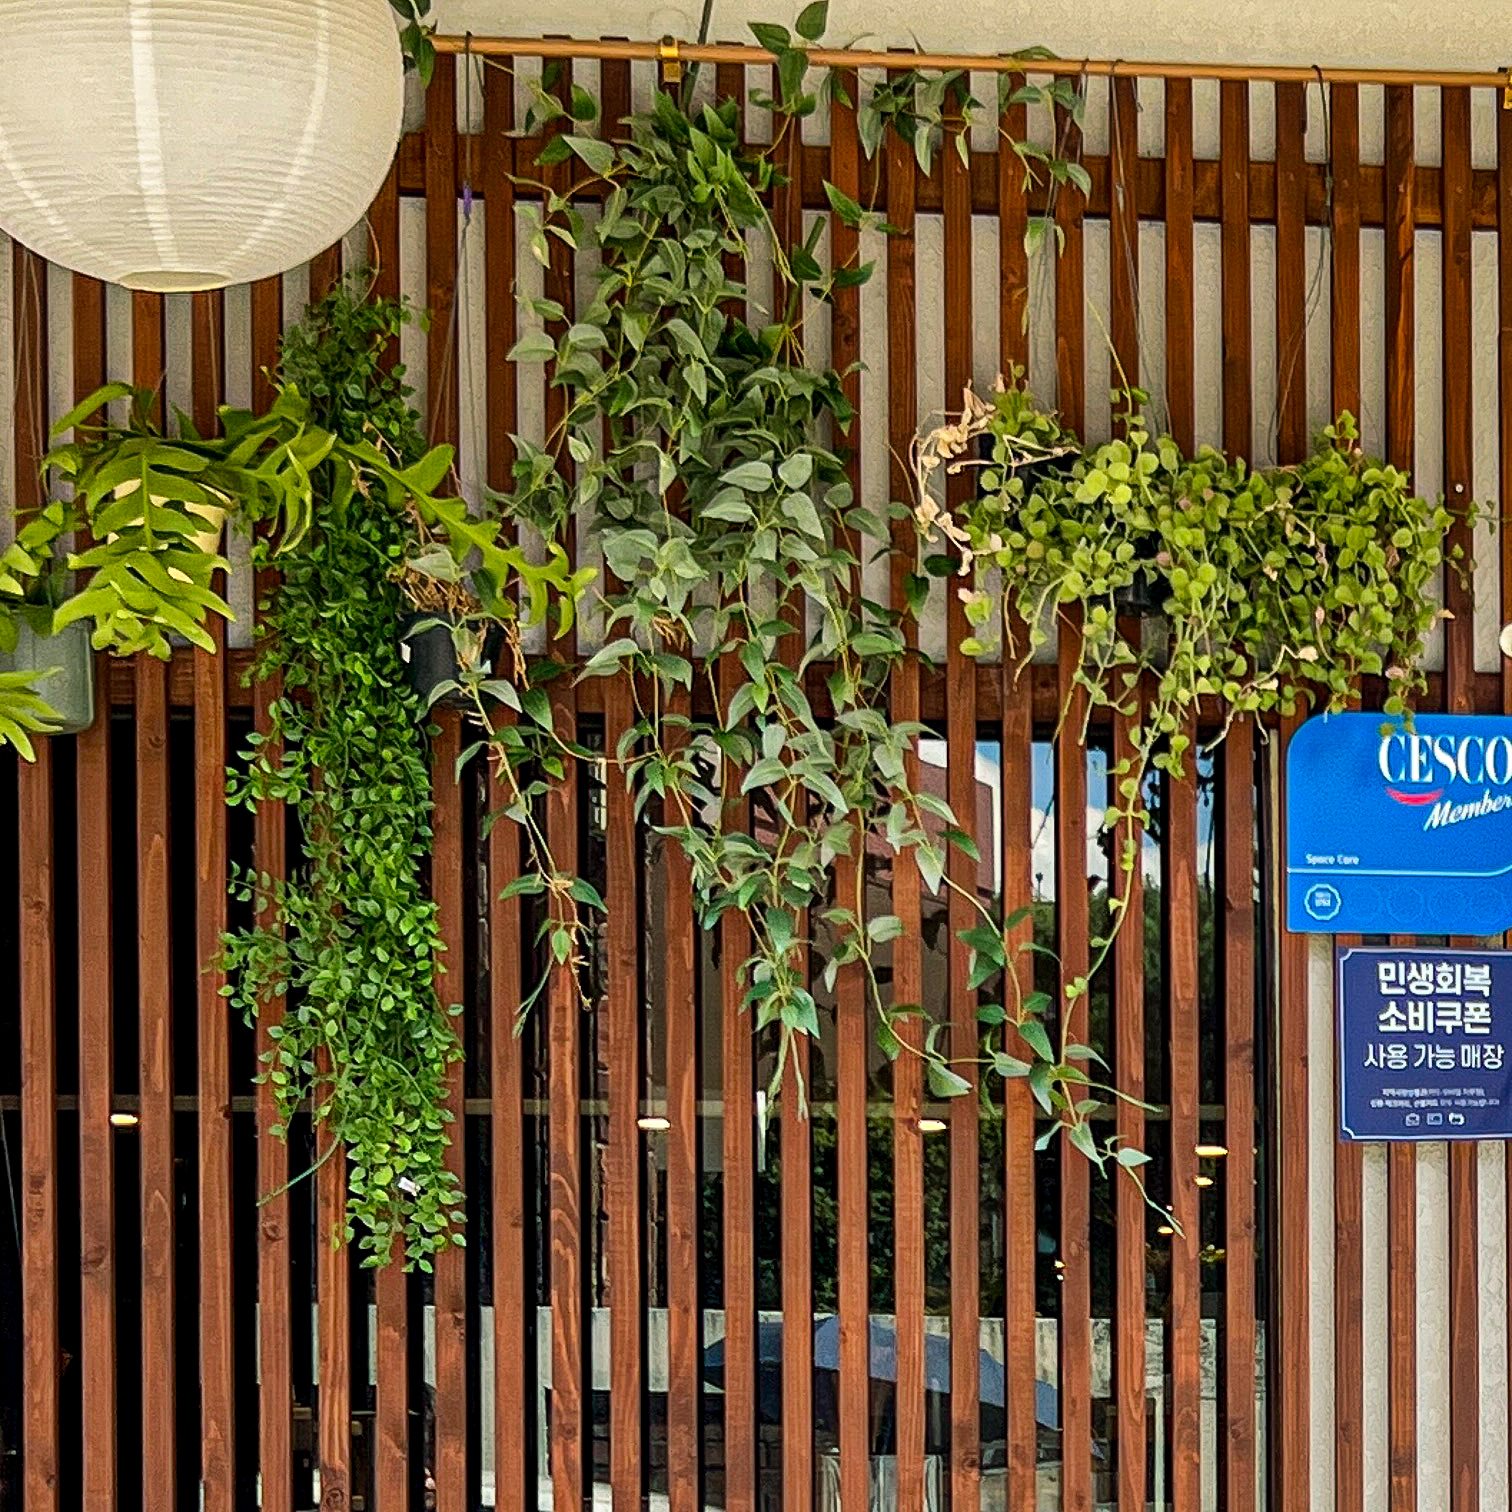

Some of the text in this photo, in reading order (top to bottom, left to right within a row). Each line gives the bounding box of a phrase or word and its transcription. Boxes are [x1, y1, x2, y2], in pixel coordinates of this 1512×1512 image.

[1378, 961, 1492, 997] 민생회복
[1378, 1001, 1492, 1034] 소비쿠폰
[1364, 1043, 1505, 1070] 사용 가능 매장
